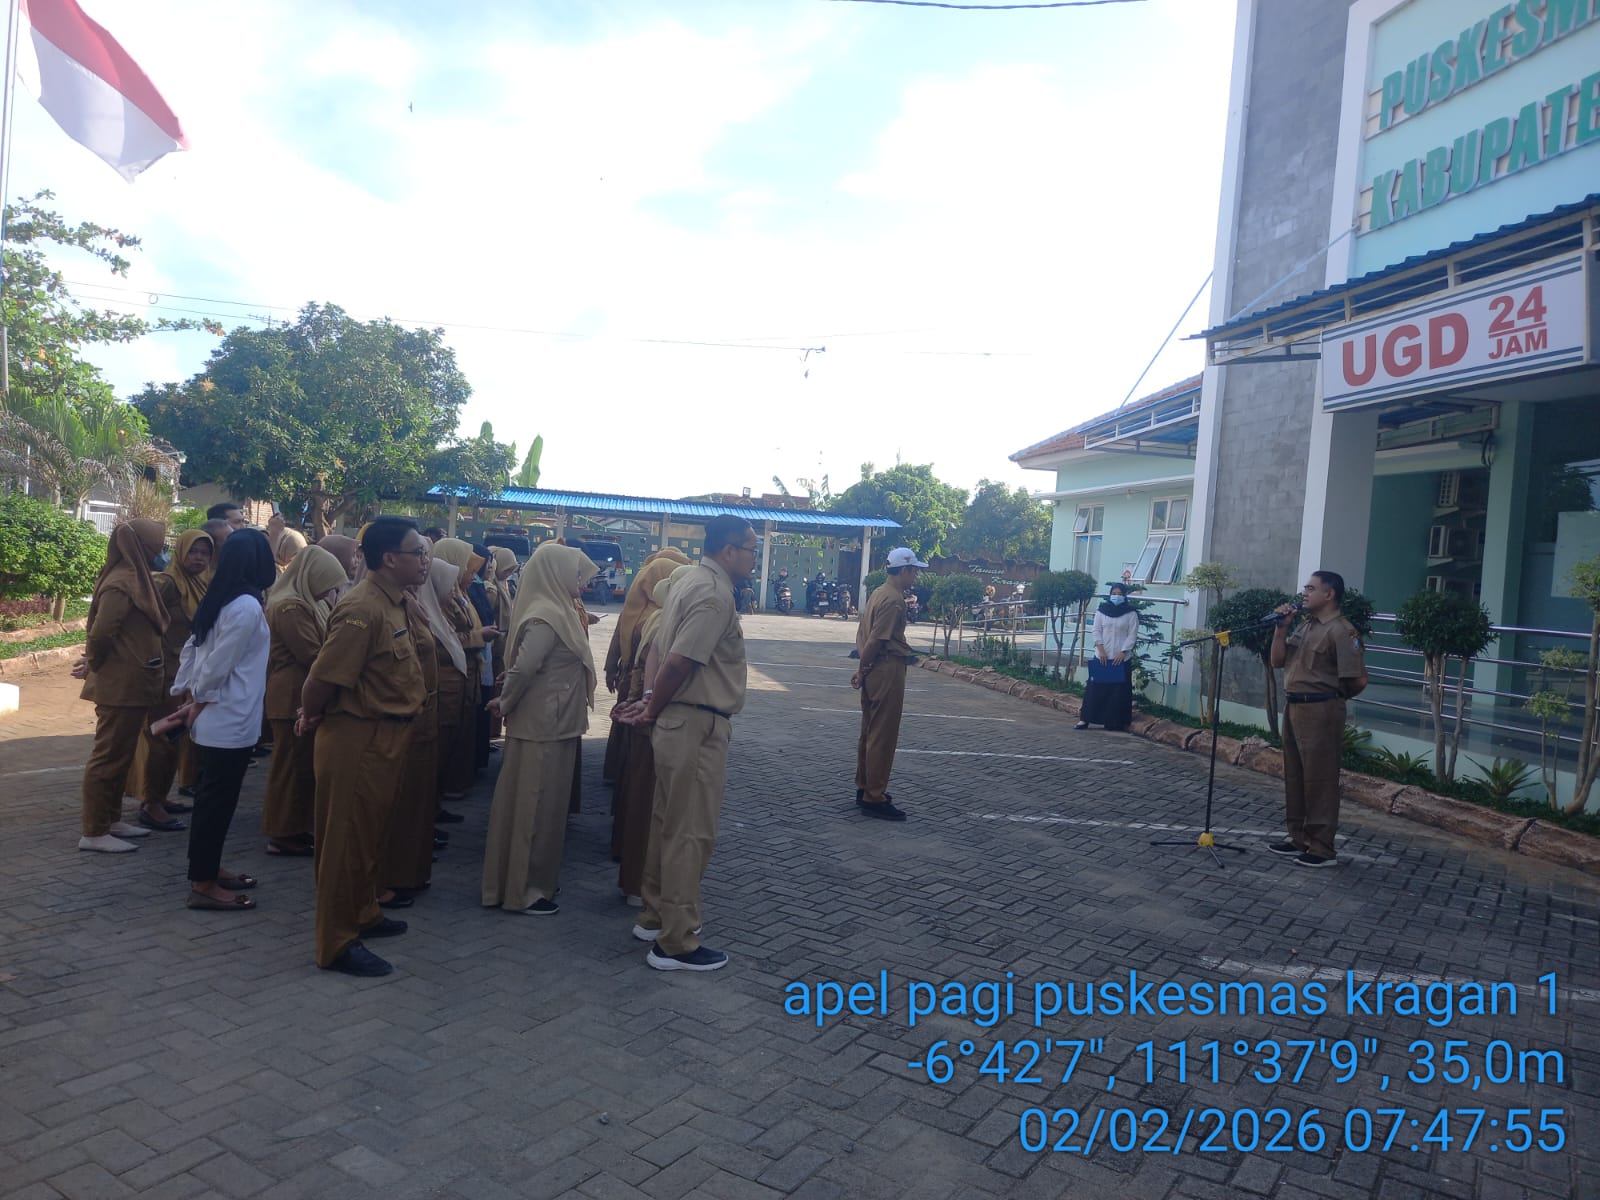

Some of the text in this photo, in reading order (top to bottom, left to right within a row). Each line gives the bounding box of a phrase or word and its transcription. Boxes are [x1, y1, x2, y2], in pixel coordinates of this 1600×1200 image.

[1380, 0, 1600, 130] PUSKESM
[1488, 285, 1547, 334] 24
[1343, 312, 1469, 387] UGD
[1488, 328, 1548, 360] JAM
